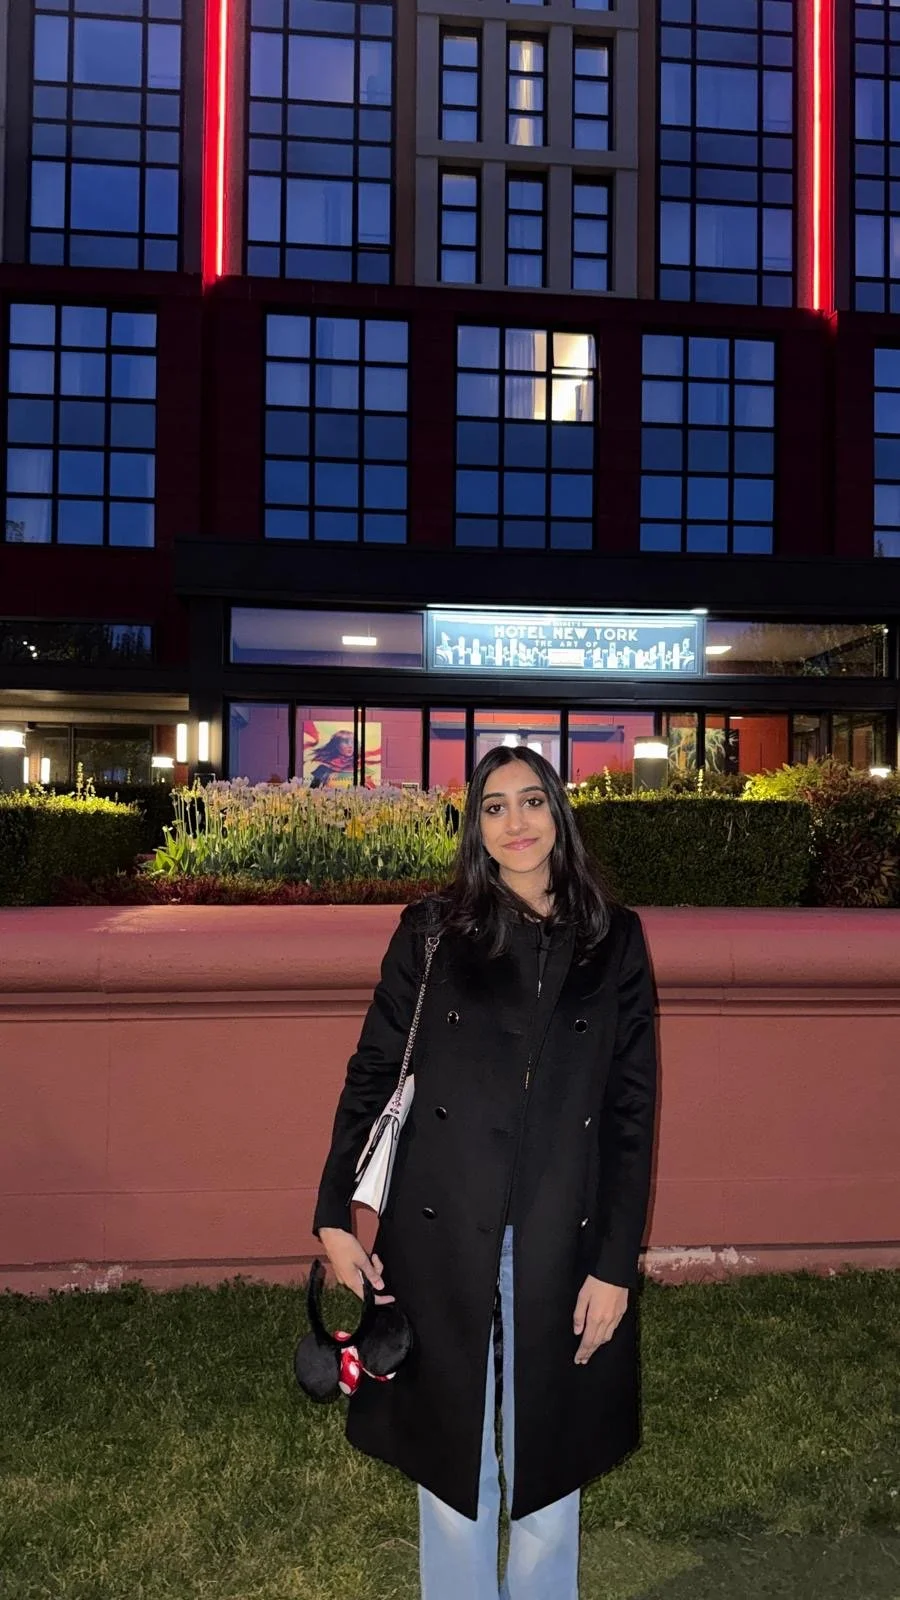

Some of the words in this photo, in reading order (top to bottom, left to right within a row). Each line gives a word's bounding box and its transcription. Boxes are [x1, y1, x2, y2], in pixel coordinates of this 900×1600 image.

[494, 625, 546, 639] HOTEL
[553, 626, 588, 640] NEW
[595, 628, 638, 641] YORK
